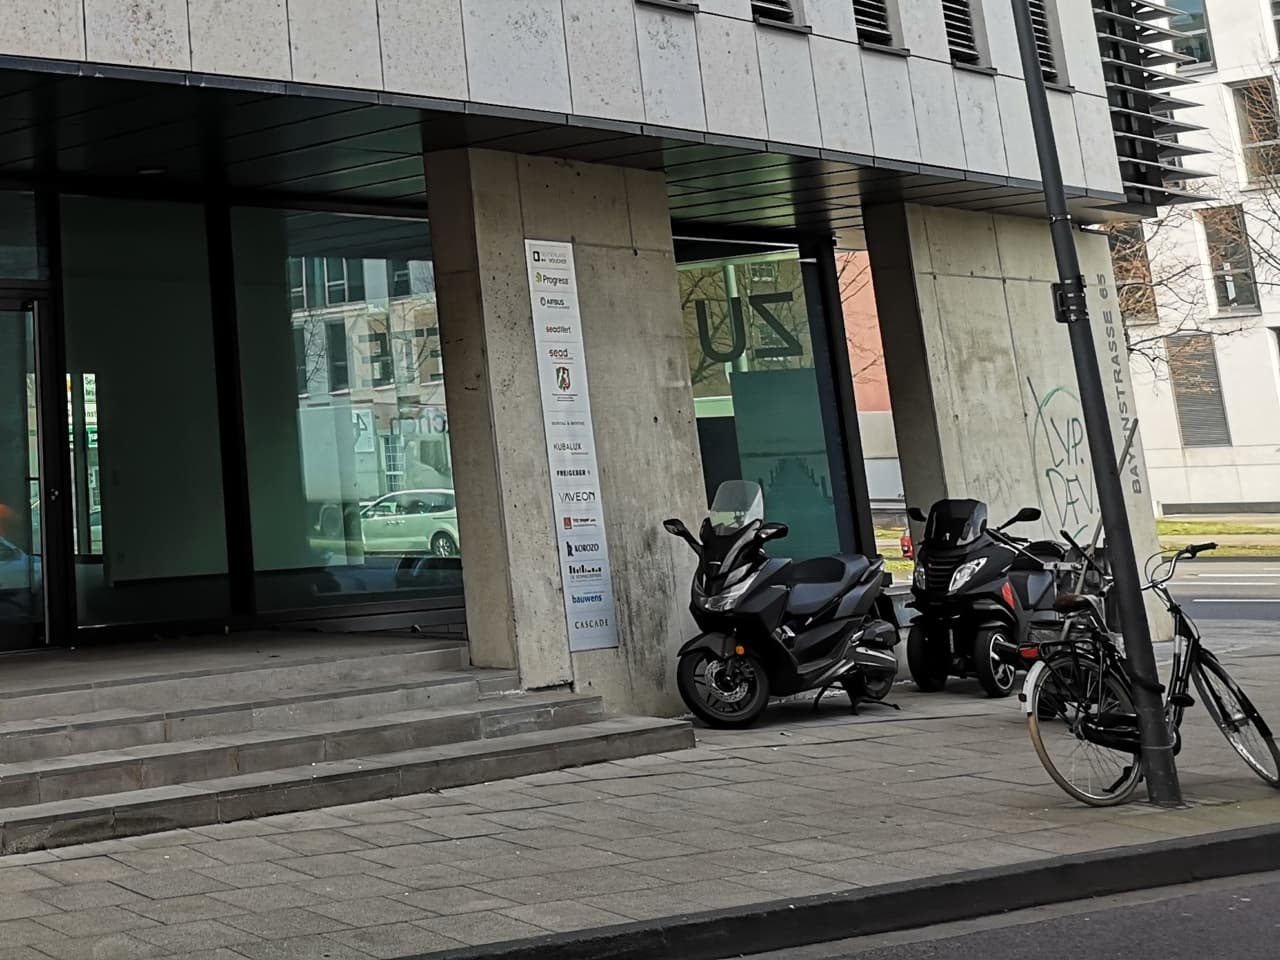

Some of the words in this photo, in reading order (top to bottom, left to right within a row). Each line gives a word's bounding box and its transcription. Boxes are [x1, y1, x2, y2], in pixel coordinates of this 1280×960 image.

[543, 275, 569, 287] Progress
[1097, 272, 1110, 300] 65
[574, 543, 600, 553] KOROZO
[571, 594, 603, 604] bauwens
[574, 618, 609, 630] CASCADE
